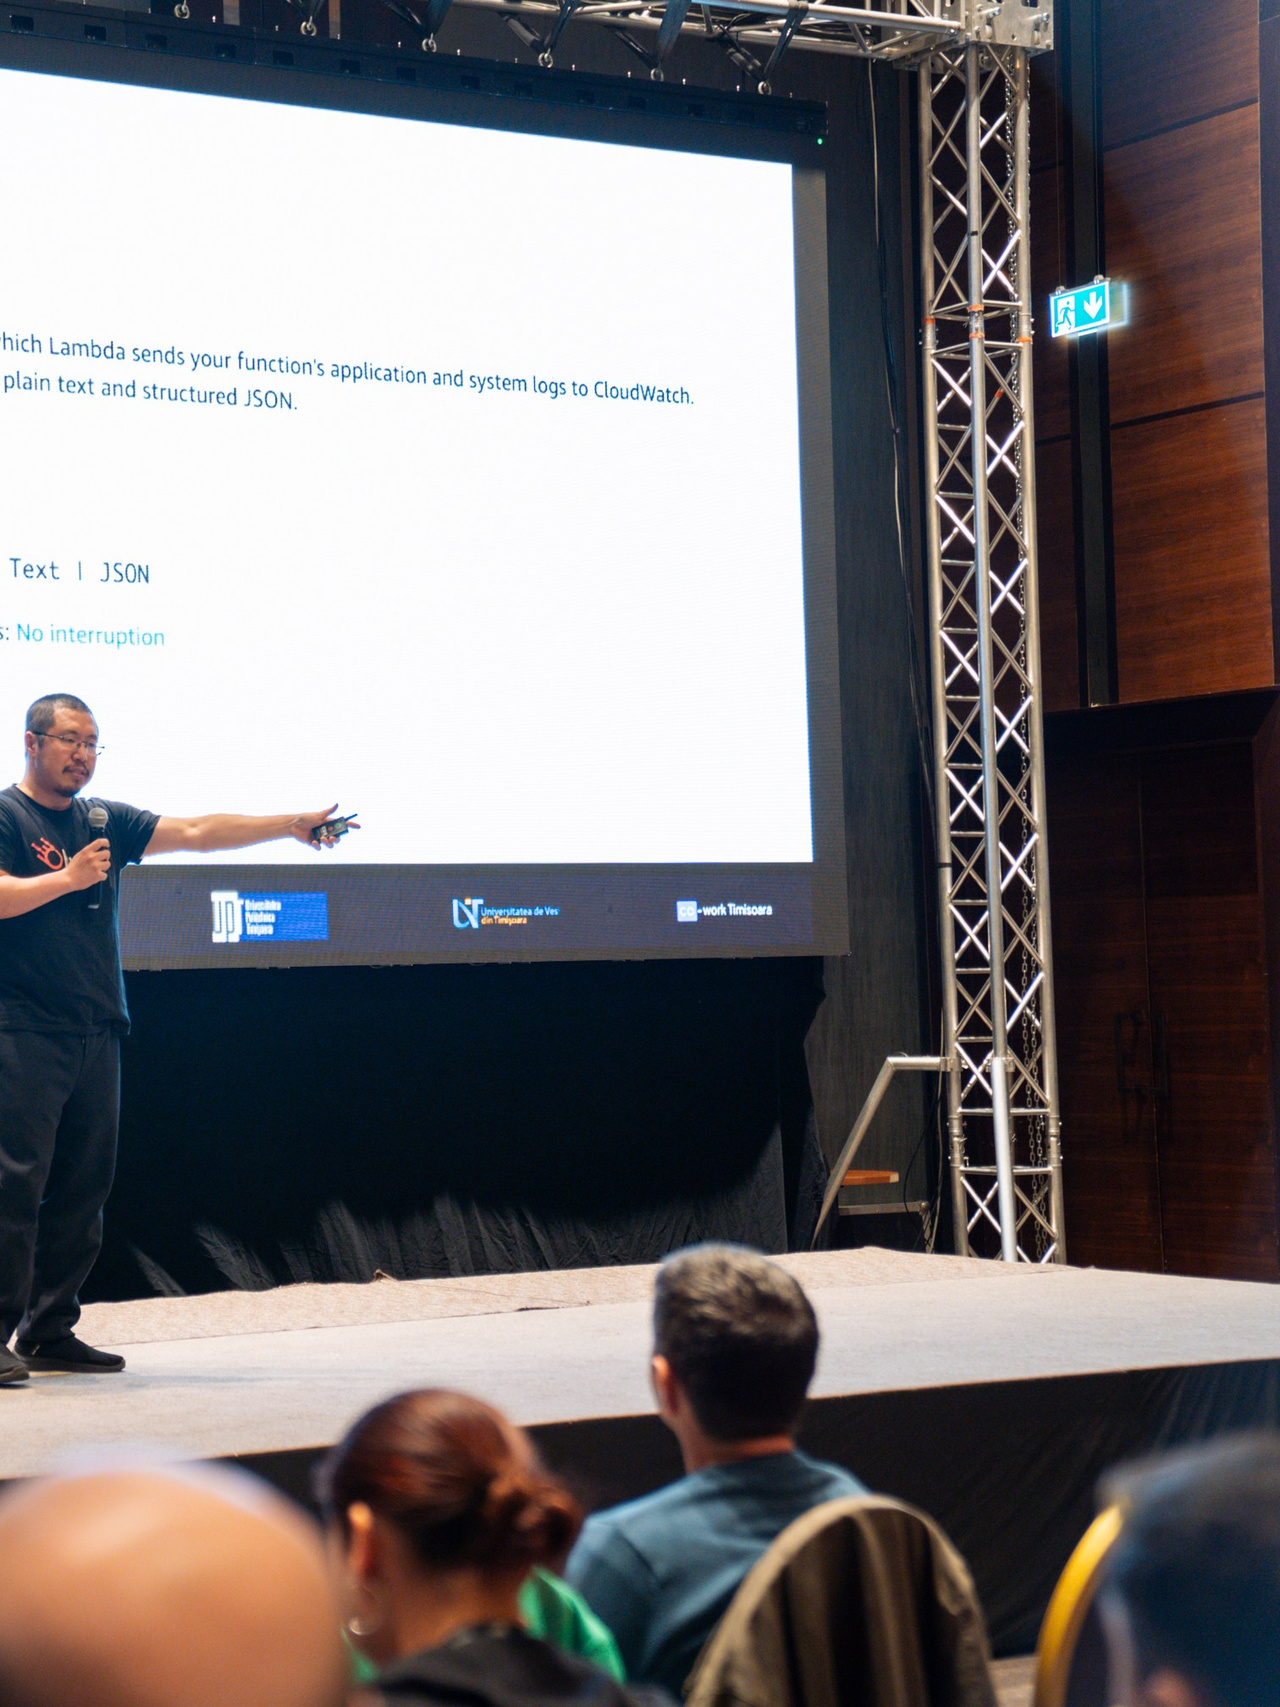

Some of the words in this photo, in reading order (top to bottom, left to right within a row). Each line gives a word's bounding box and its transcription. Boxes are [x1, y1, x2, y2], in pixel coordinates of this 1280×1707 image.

[49, 336, 126, 361] Lambda
[132, 345, 185, 366] sends
[190, 351, 231, 372] your
[237, 350, 325, 377] function's
[331, 362, 427, 386] application
[433, 369, 464, 388] and
[469, 373, 527, 394] system
[533, 375, 567, 399] logs
[572, 380, 588, 397] to
[594, 381, 695, 405] CloudWatch.
[3, 371, 51, 393] plain
[58, 375, 95, 396] text
[101, 379, 136, 399] and
[142, 383, 237, 406] structured
[243, 389, 298, 410] JSON.
[9, 557, 60, 580] Text
[100, 562, 150, 584] JSON
[17, 623, 43, 643] No
[50, 624, 166, 649] interruption
[534, 906, 544, 916] de
[727, 902, 773, 916] Timisoara
